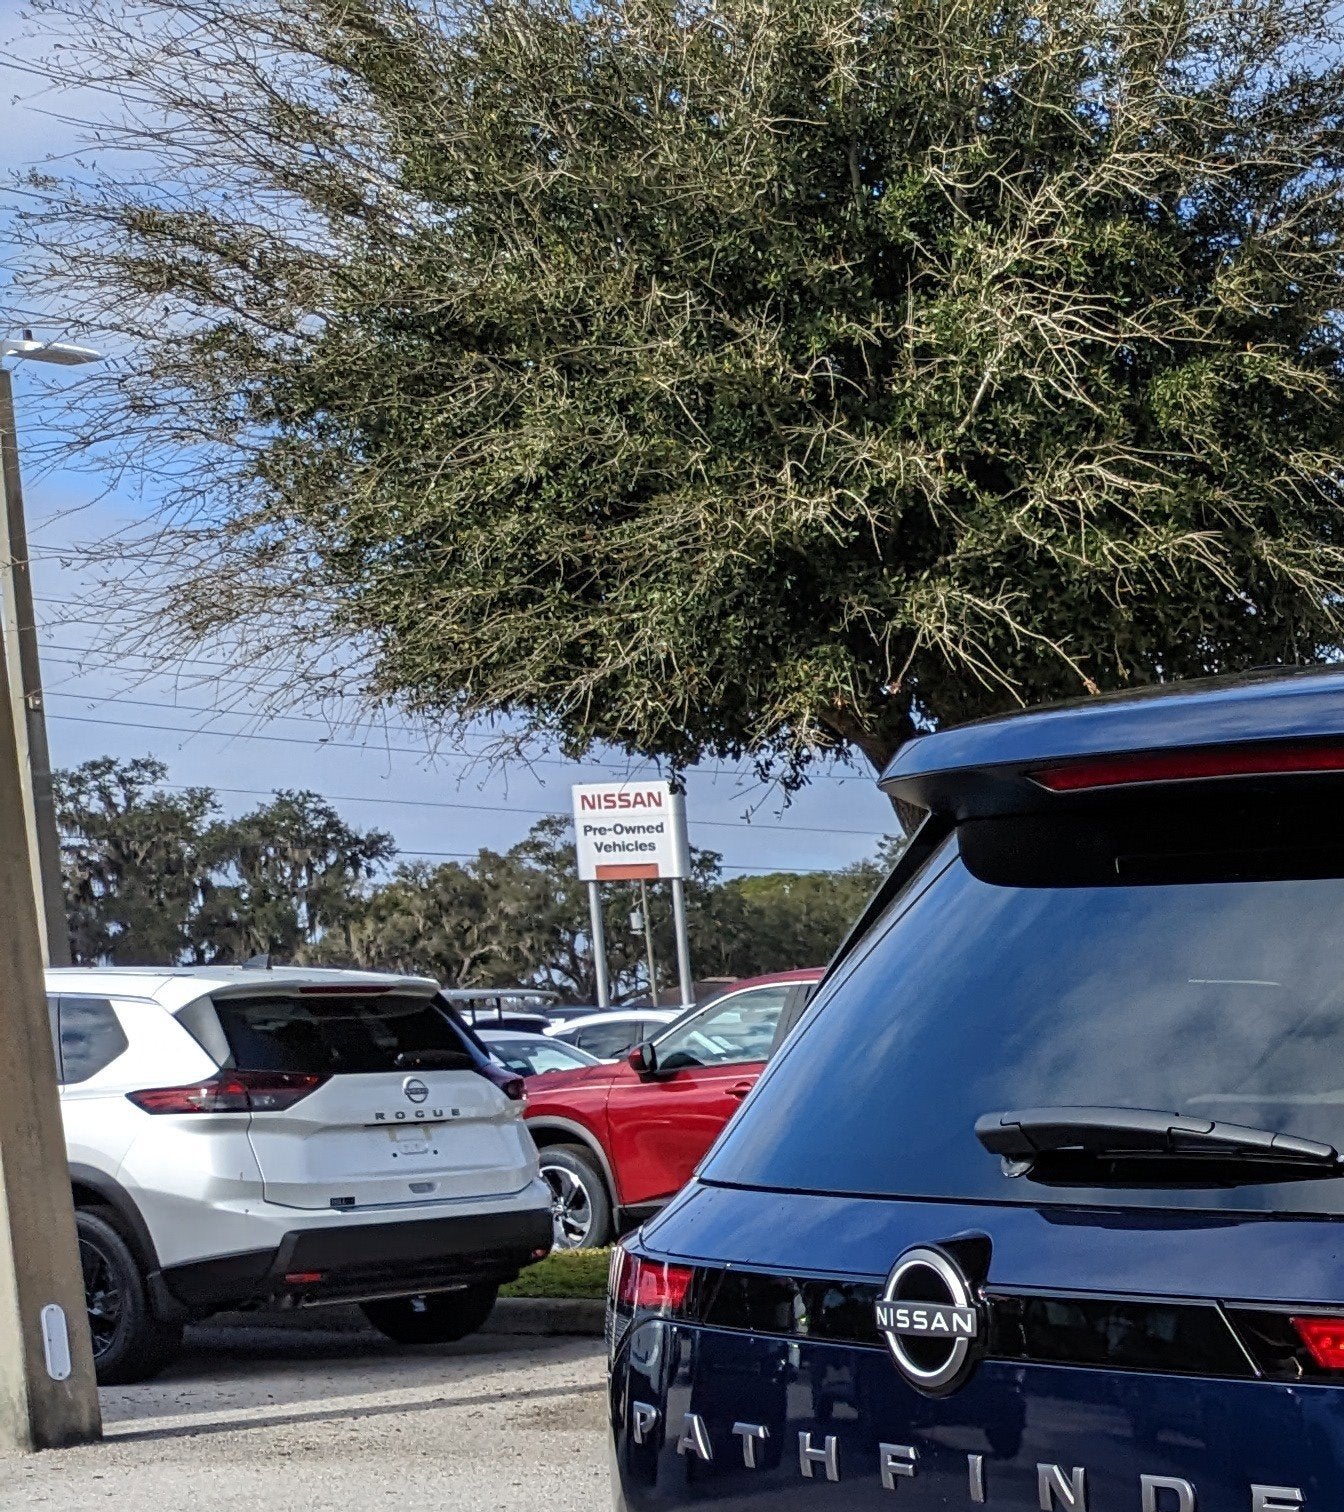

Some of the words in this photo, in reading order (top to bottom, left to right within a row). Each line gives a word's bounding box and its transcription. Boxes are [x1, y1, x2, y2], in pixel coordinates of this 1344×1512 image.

[580, 791, 662, 811] NISSAN
[583, 822, 665, 837] Pre-Owned
[594, 840, 656, 853] Vehicles
[375, 1108, 460, 1120] ROGUE
[876, 1306, 973, 1333] NISSAN
